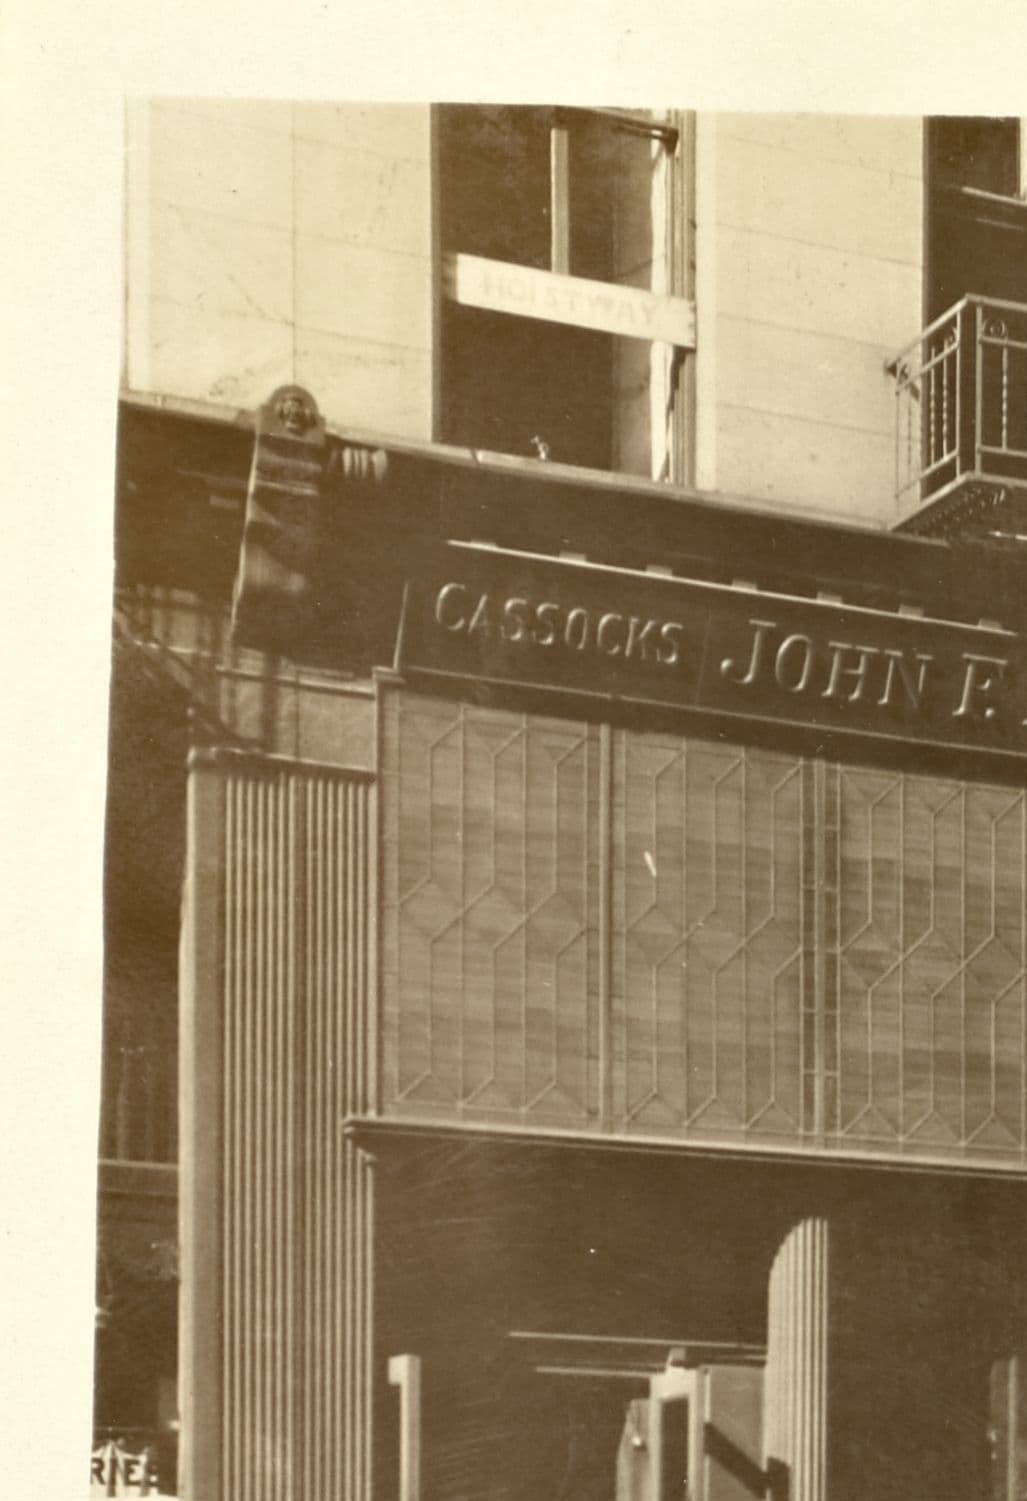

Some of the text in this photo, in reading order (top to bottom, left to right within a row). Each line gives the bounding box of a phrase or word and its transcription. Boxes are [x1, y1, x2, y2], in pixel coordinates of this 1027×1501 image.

[480, 268, 659, 327] HOISTWAY
[435, 582, 683, 664] CASSOCKS
[719, 617, 935, 709] JOHN
[951, 652, 1008, 720] F.
